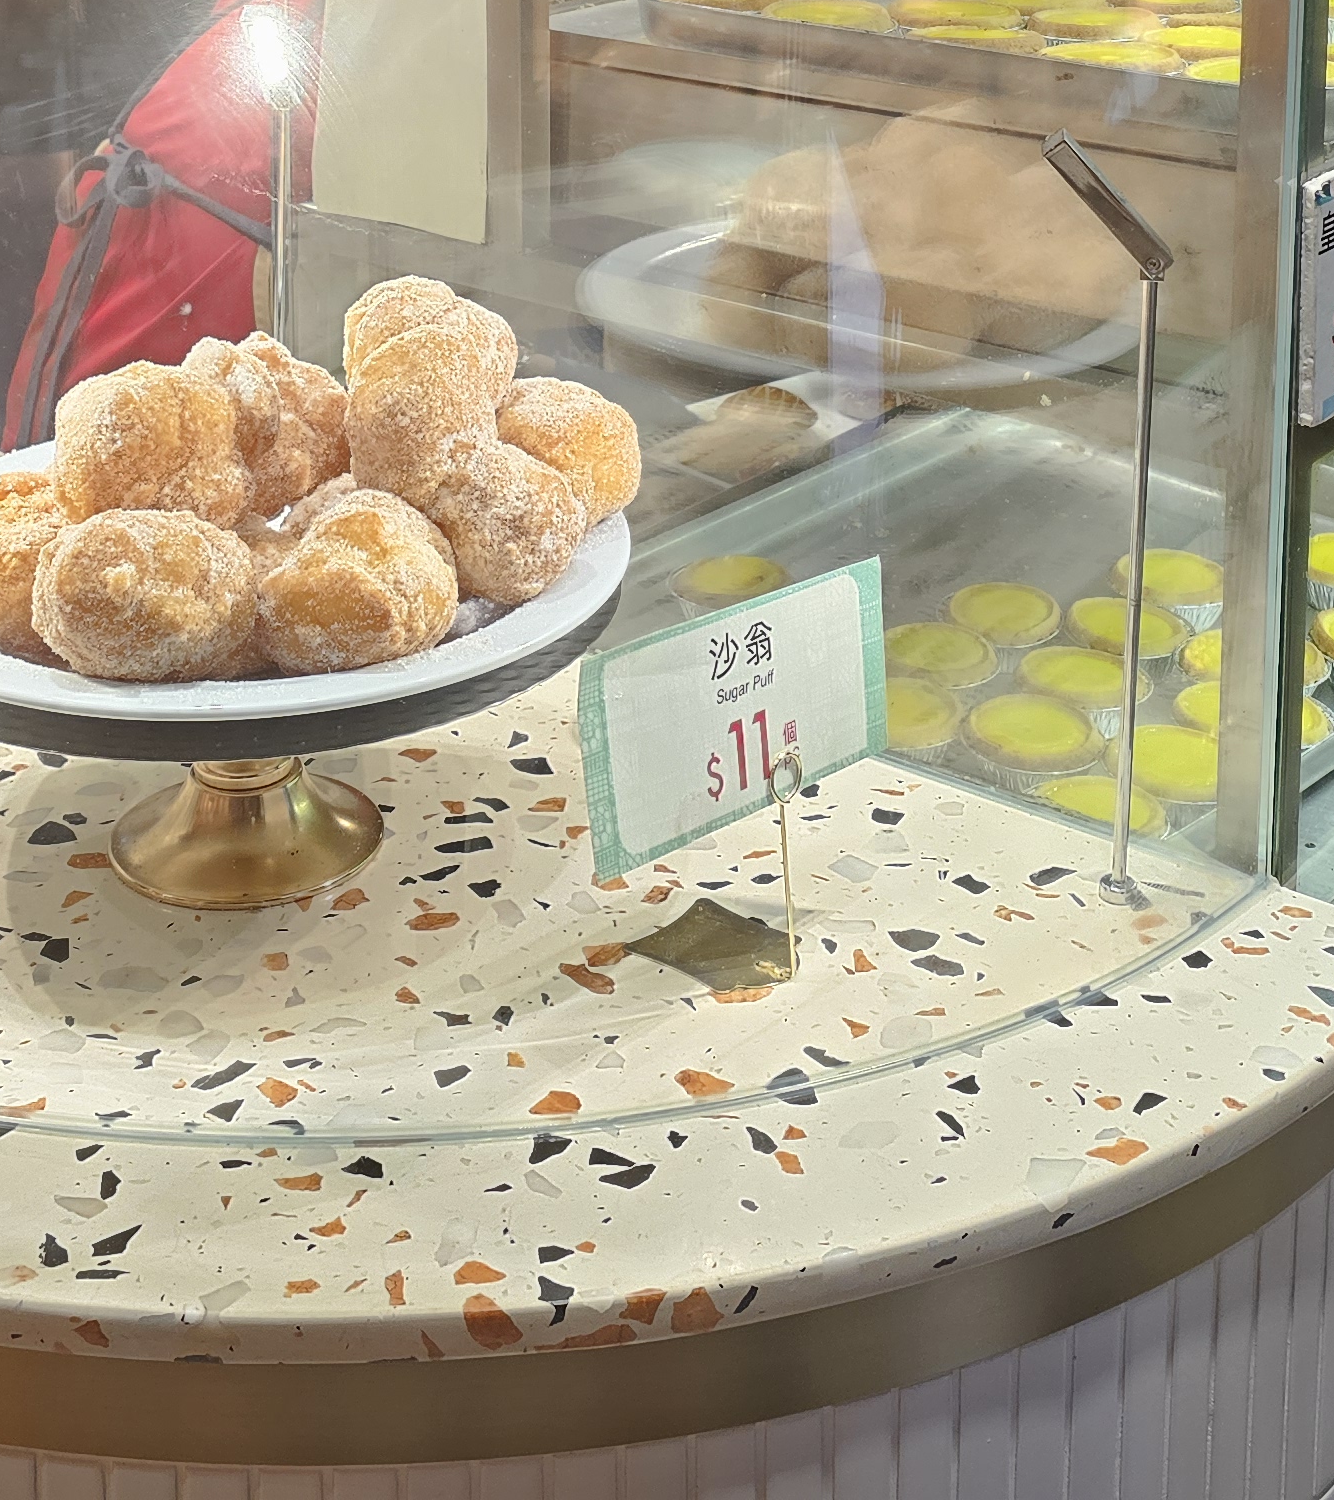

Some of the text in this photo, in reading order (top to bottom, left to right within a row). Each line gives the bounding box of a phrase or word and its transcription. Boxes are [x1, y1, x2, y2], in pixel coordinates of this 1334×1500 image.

[709, 620, 772, 681] 沙翁
[716, 669, 775, 705] Sugar Puff
[707, 708, 772, 801] $11
[782, 719, 798, 746] 個
